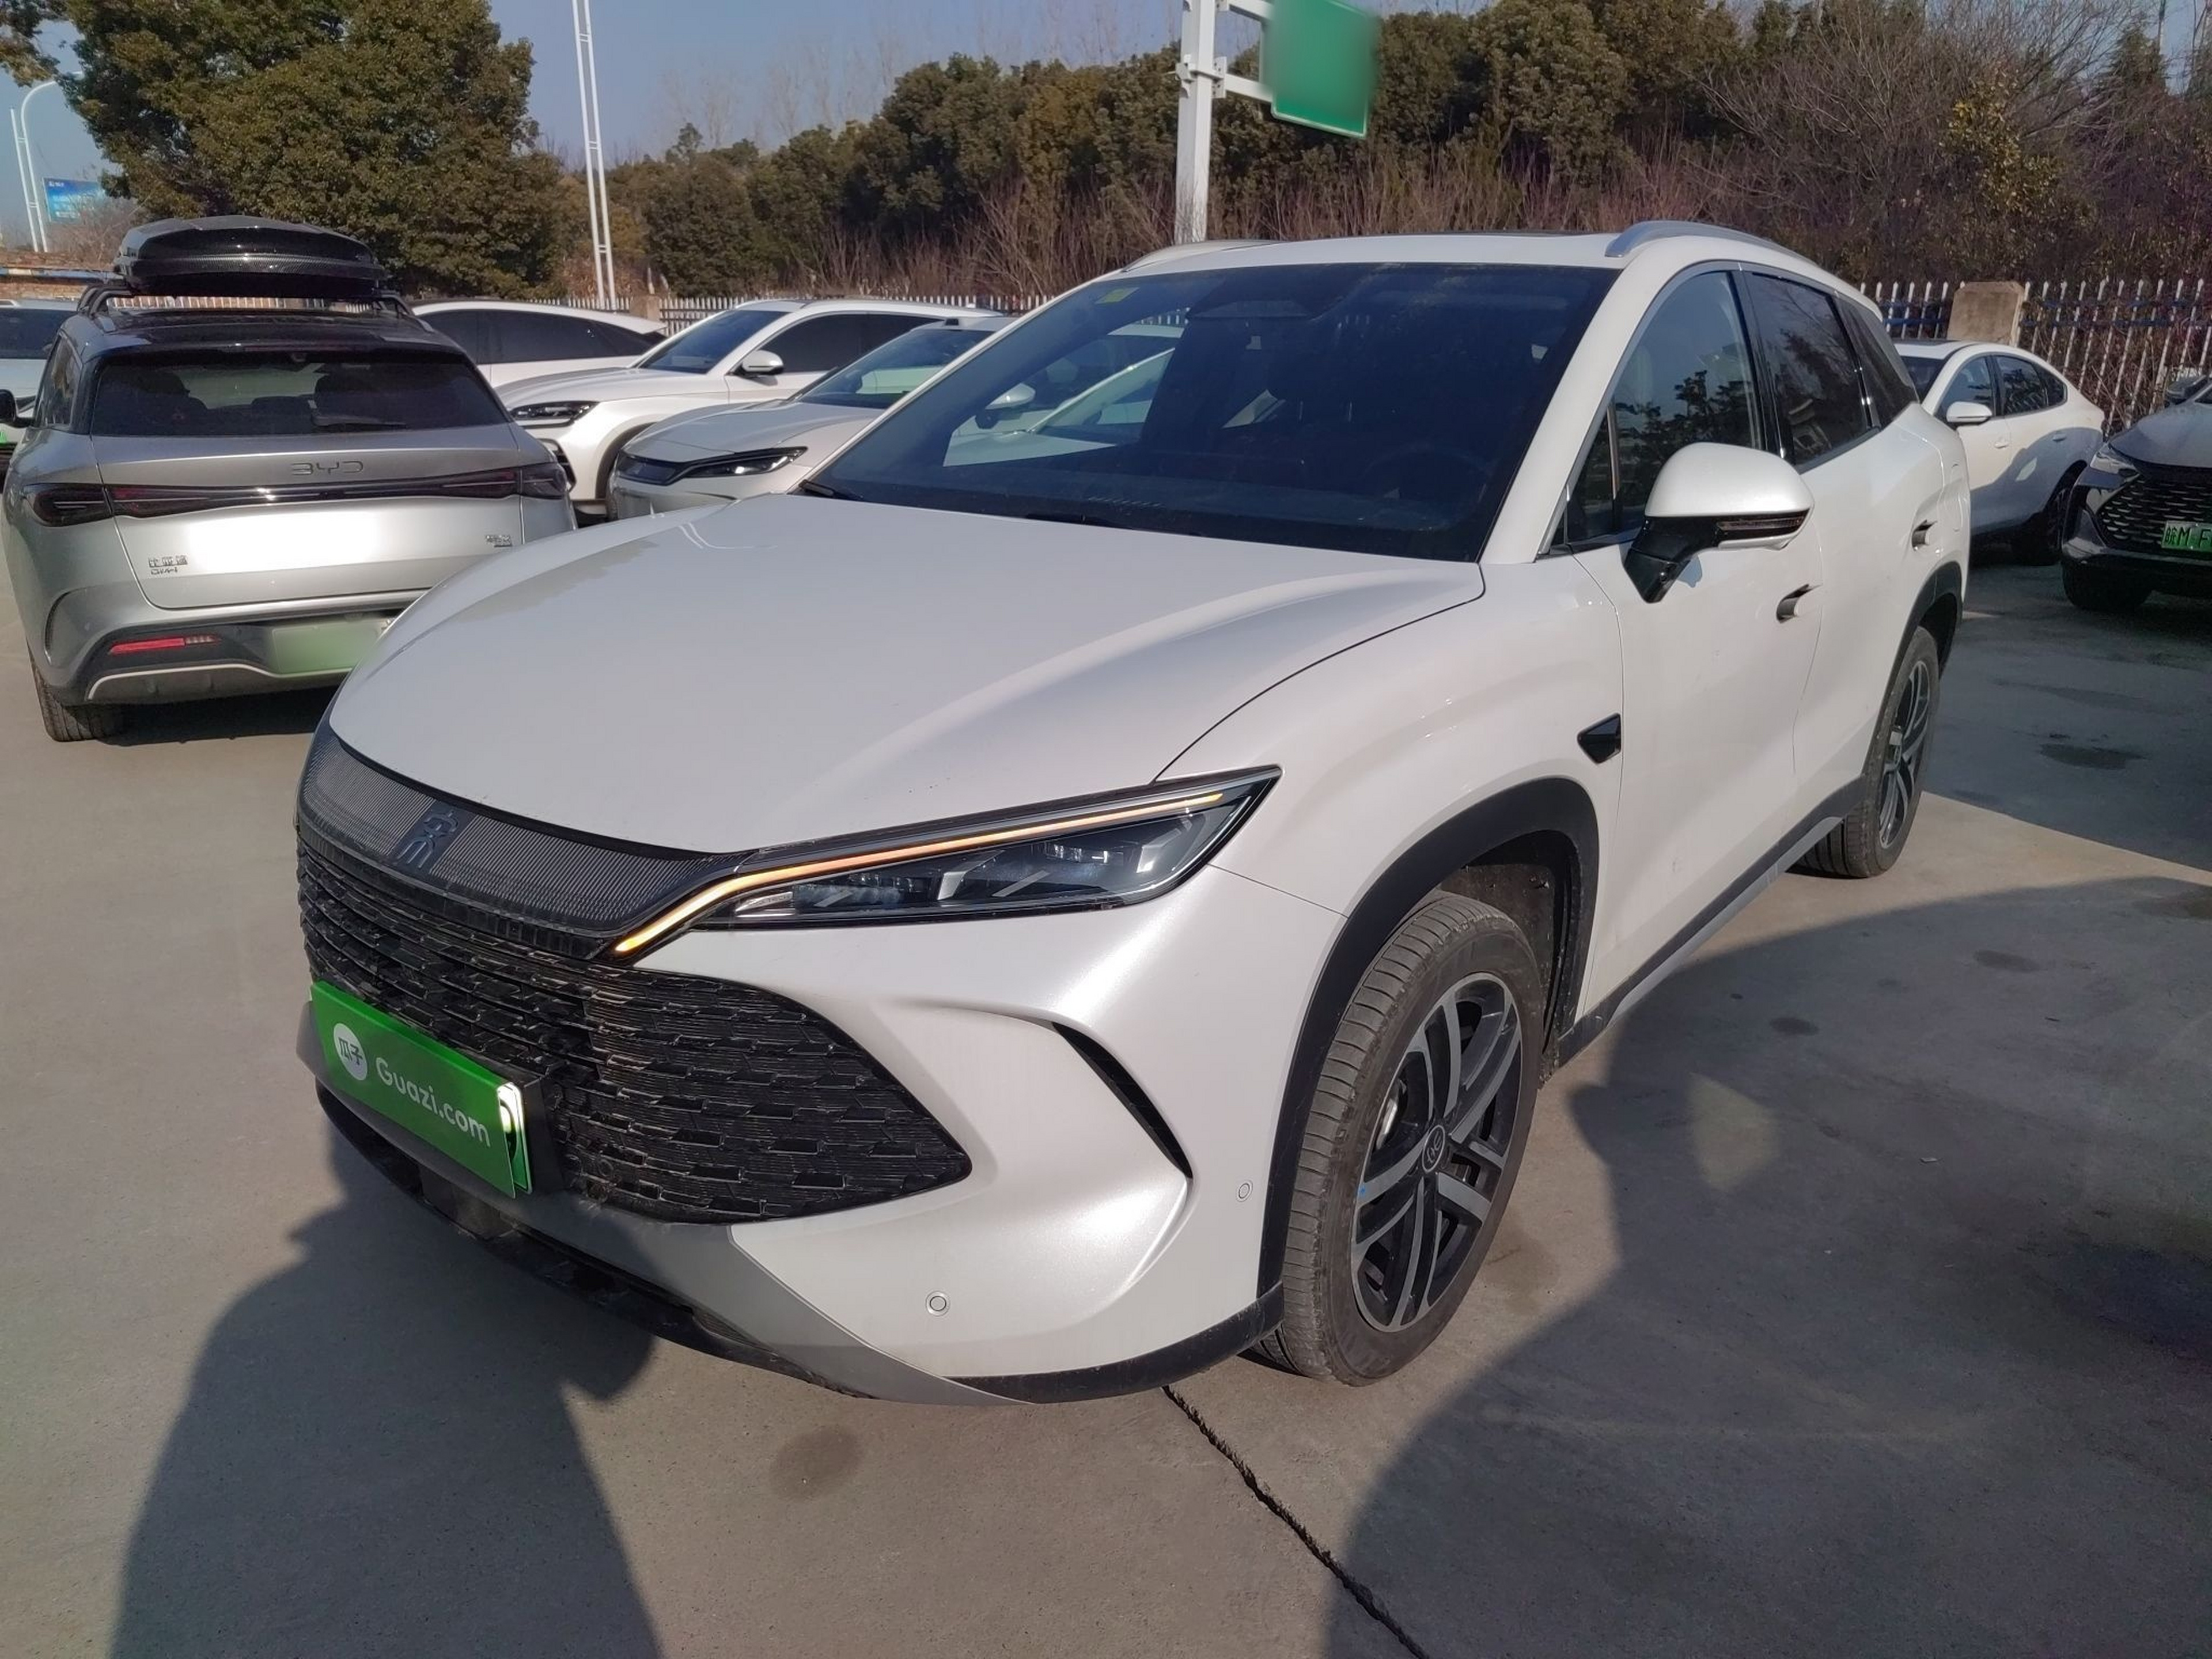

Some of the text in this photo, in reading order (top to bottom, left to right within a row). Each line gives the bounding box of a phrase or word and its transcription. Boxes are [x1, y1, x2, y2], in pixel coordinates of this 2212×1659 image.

[290, 460, 364, 476] BYD
[338, 1036, 363, 1066] 瓜子
[376, 1057, 491, 1147] Guazi.com
